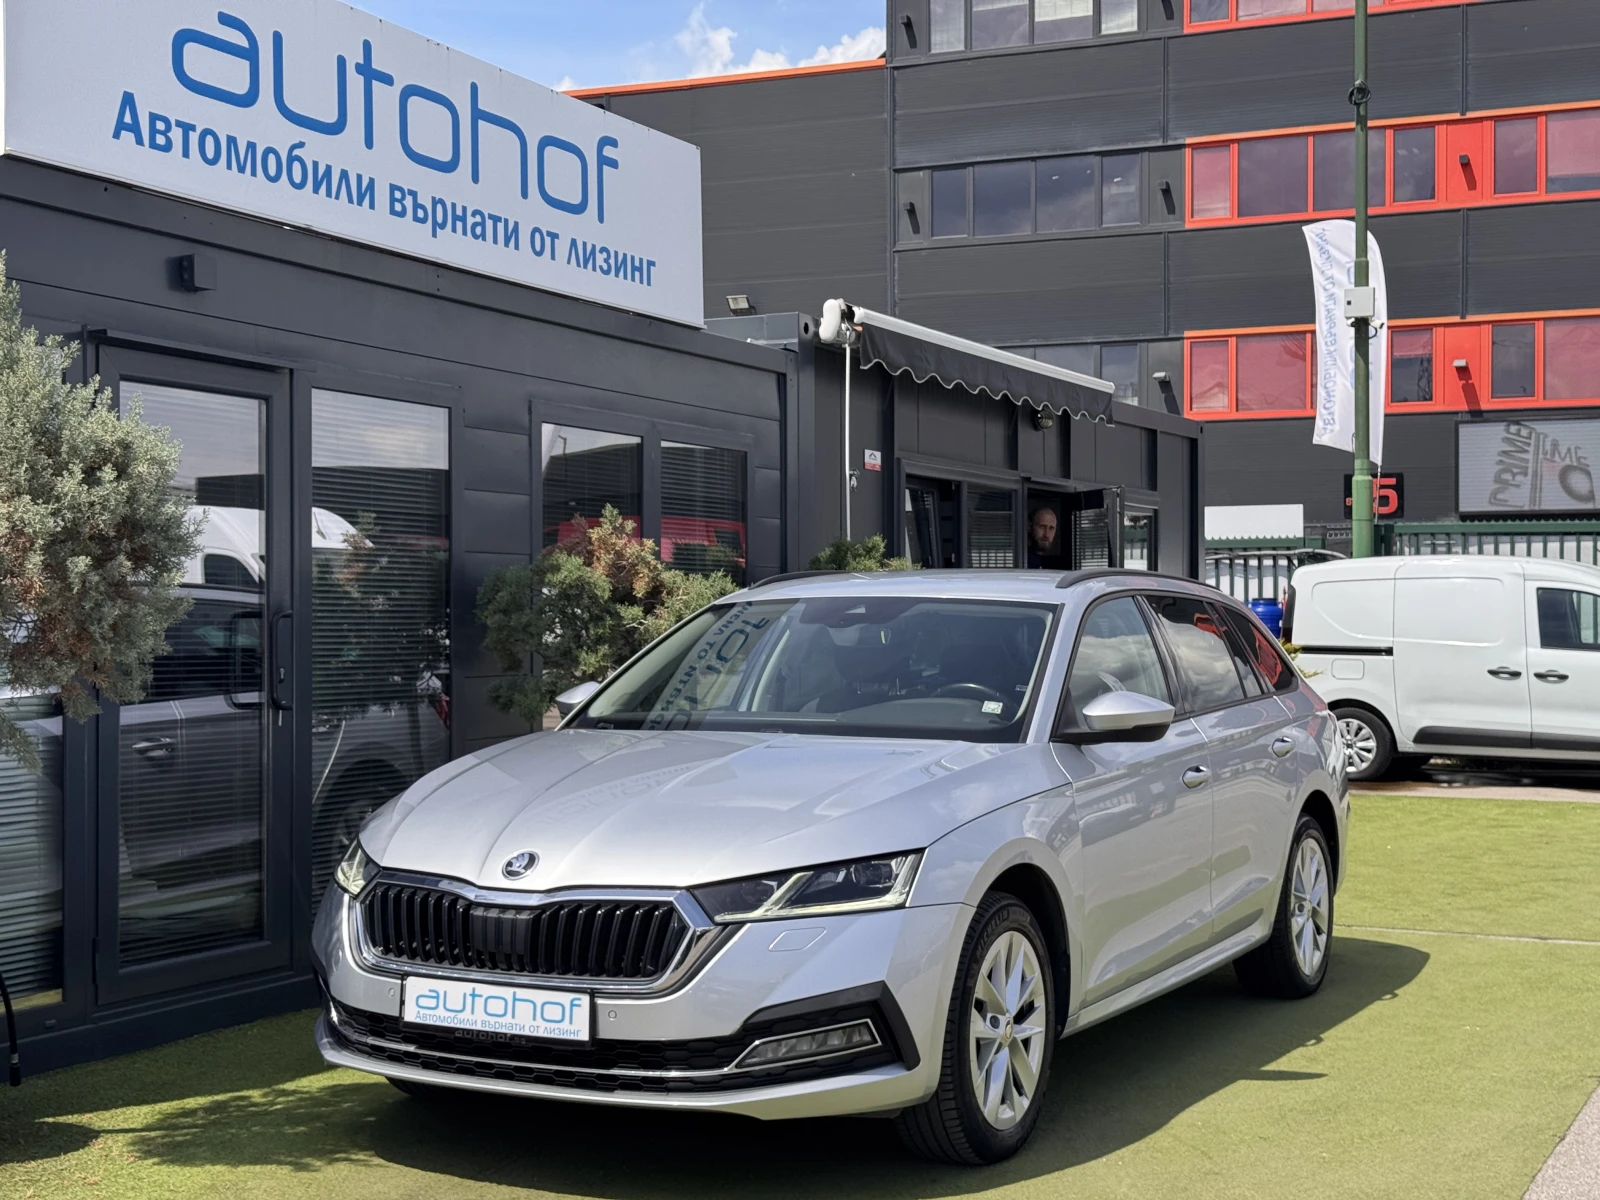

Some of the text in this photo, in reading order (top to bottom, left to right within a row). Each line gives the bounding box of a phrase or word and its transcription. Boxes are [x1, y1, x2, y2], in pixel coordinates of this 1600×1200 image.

[172, 12, 619, 224] autohof
[112, 91, 656, 286] Автомобили върнати от лизинг
[414, 1010, 582, 1038] Автомобили върнати от лизинг
[415, 987, 582, 1025] autohof
